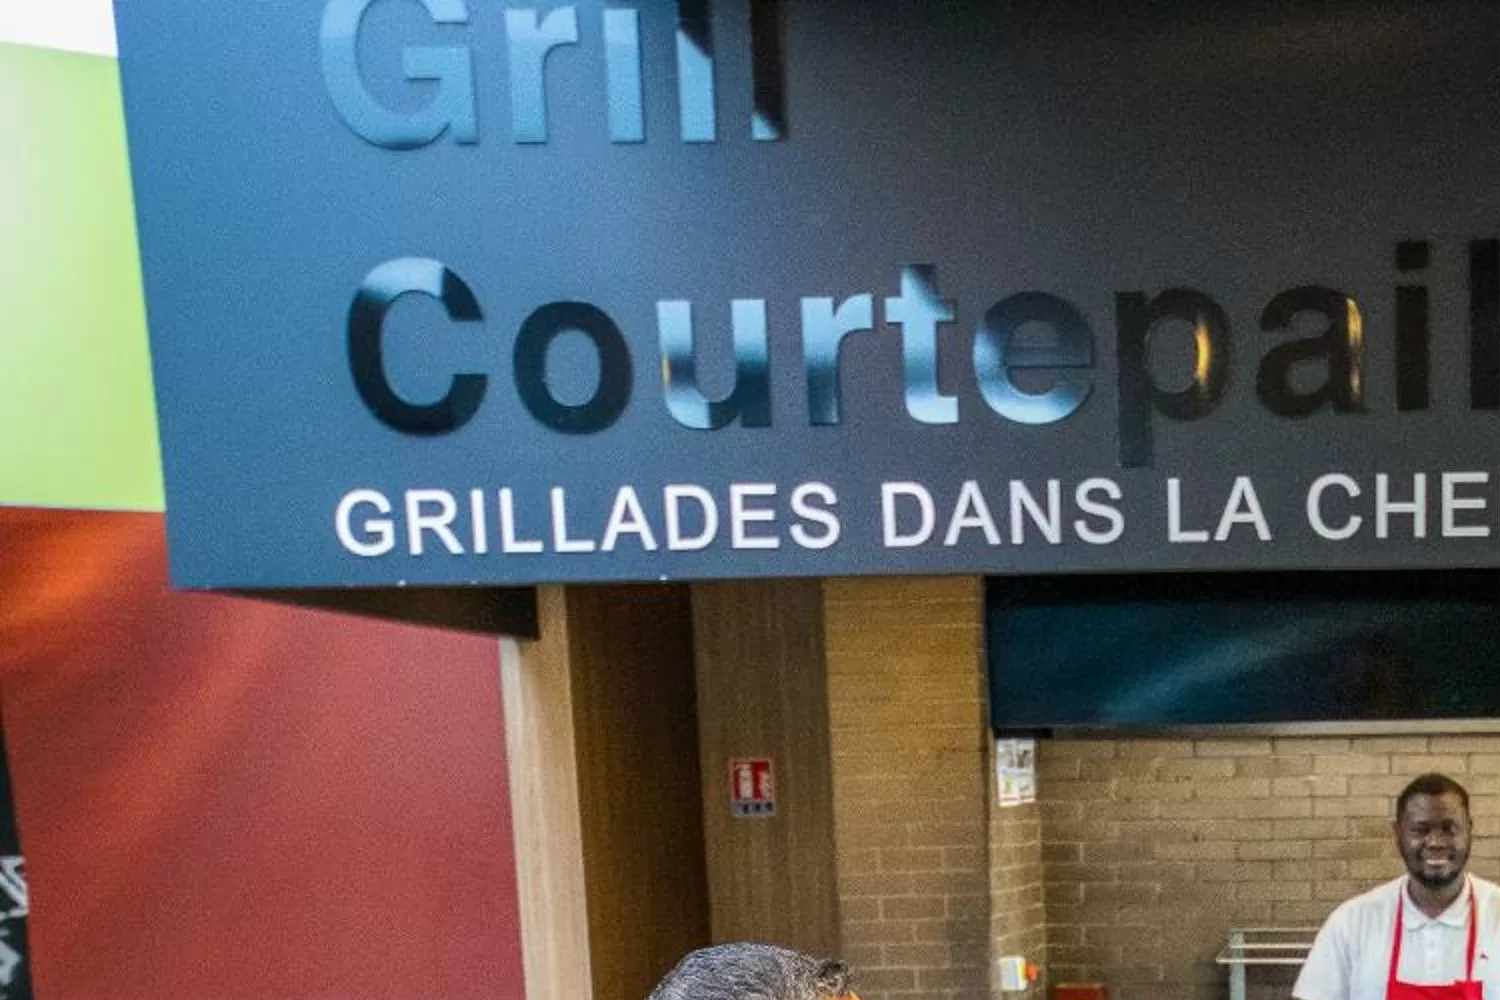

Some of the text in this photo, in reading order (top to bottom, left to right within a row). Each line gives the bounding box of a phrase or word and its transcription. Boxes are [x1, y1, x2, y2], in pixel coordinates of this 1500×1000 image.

[320, 0, 788, 151] Grill
[334, 483, 841, 557] GRILLADES
[882, 477, 1126, 548] DANS
[1167, 475, 1272, 542] LA
